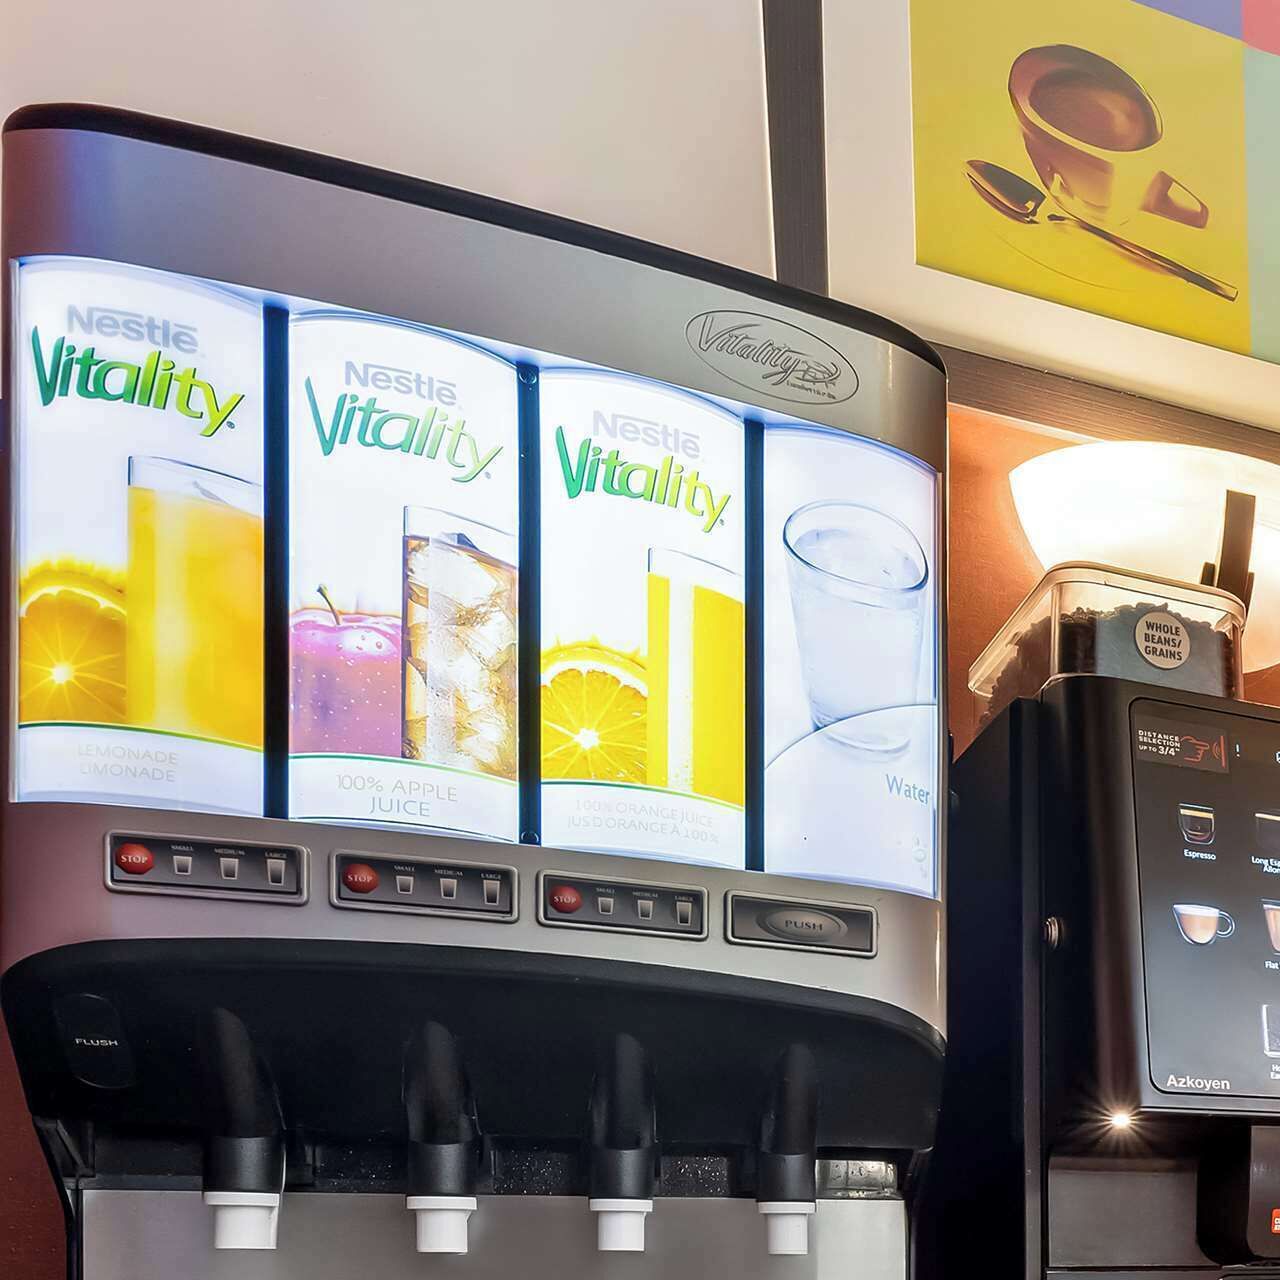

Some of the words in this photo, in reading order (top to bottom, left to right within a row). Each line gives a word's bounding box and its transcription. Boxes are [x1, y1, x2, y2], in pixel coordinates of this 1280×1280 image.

[699, 315, 811, 386] Vitality
[31, 326, 245, 437] Vitality
[304, 376, 503, 482] Vitality
[555, 425, 731, 533] Vitality
[1145, 620, 1181, 636] WHOLE
[1144, 632, 1182, 648] BEANS/
[1144, 645, 1182, 661] GRAINS
[1138, 729, 1180, 742] DISTANCE
[1138, 736, 1181, 748] SELECTION
[77, 744, 178, 766] LEMONADE
[80, 762, 177, 783] LIMONADE
[336, 774, 384, 792] 100%
[392, 779, 458, 802] APPLE
[885, 773, 930, 805] Water
[369, 796, 431, 817] JUICE
[615, 801, 679, 820] ORANGE
[680, 807, 713, 828] JUICE
[567, 815, 591, 829] JUS
[121, 854, 149, 864] STOP
[1183, 848, 1217, 861] Espresso
[347, 874, 374, 883] STOP
[553, 895, 577, 905] STOP
[785, 919, 823, 931] PUSH
[1265, 961, 1279, 970] Flat
[74, 1038, 119, 1047] FLUSH
[1166, 1074, 1231, 1091] Azkoyen
